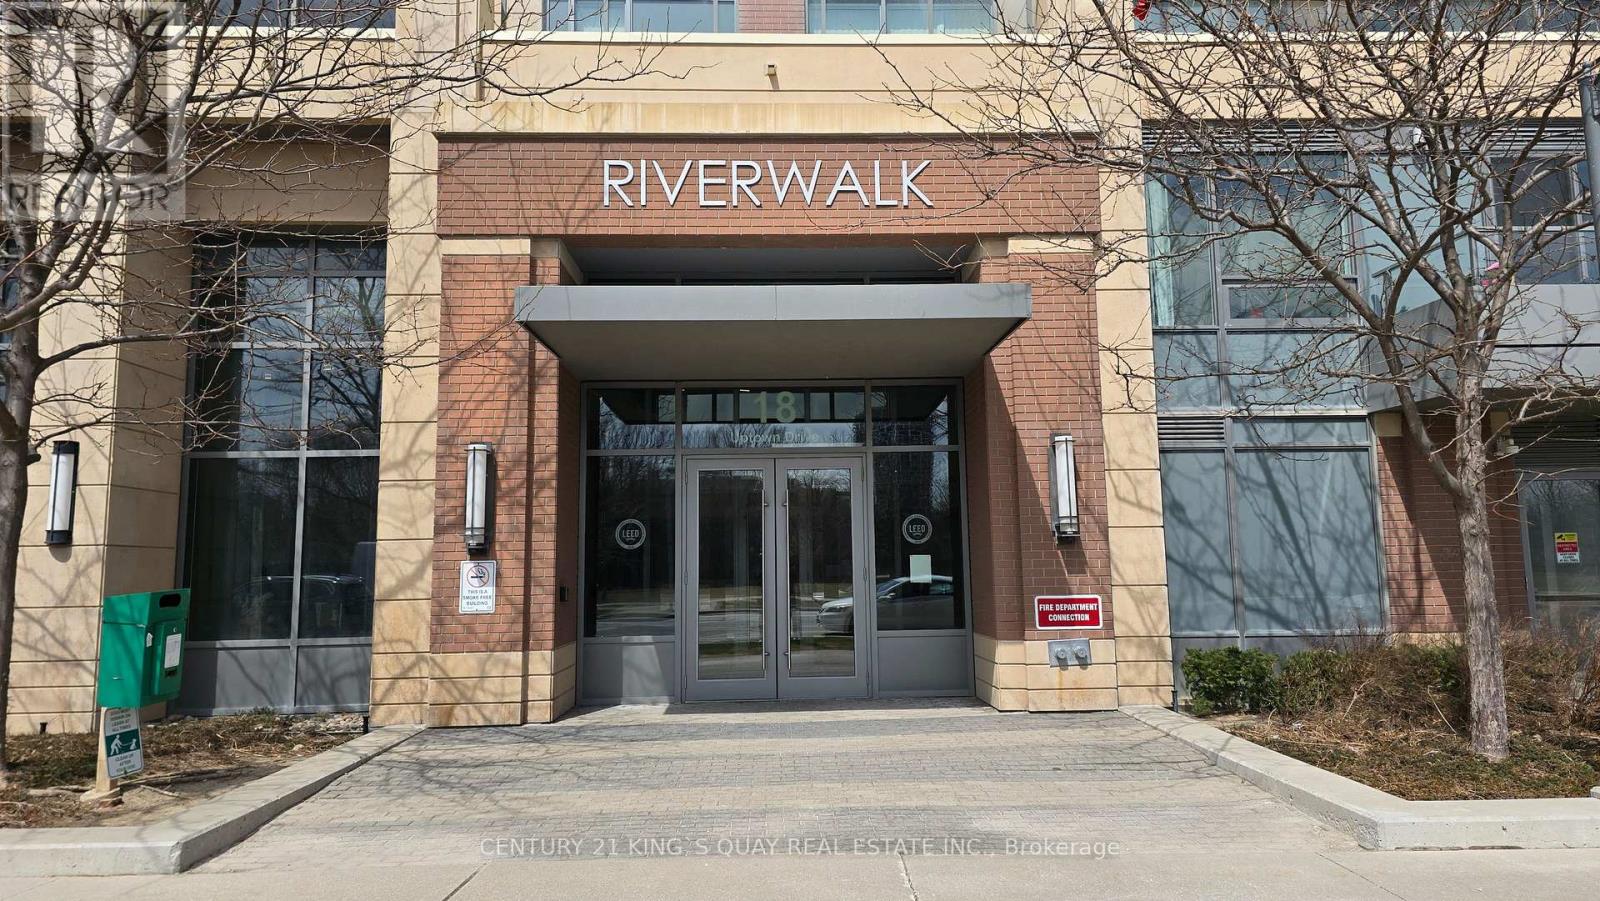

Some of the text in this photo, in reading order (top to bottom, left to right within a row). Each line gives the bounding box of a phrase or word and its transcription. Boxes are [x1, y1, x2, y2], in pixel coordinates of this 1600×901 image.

[602, 159, 934, 207] RIVERWALK
[754, 391, 796, 423] 18
[731, 431, 781, 444] Uptown
[622, 529, 640, 538] LEED
[909, 525, 926, 533] LEED
[1039, 603, 1098, 612] FIRE DEPARTMENT
[1048, 613, 1090, 622] CONNECTION
